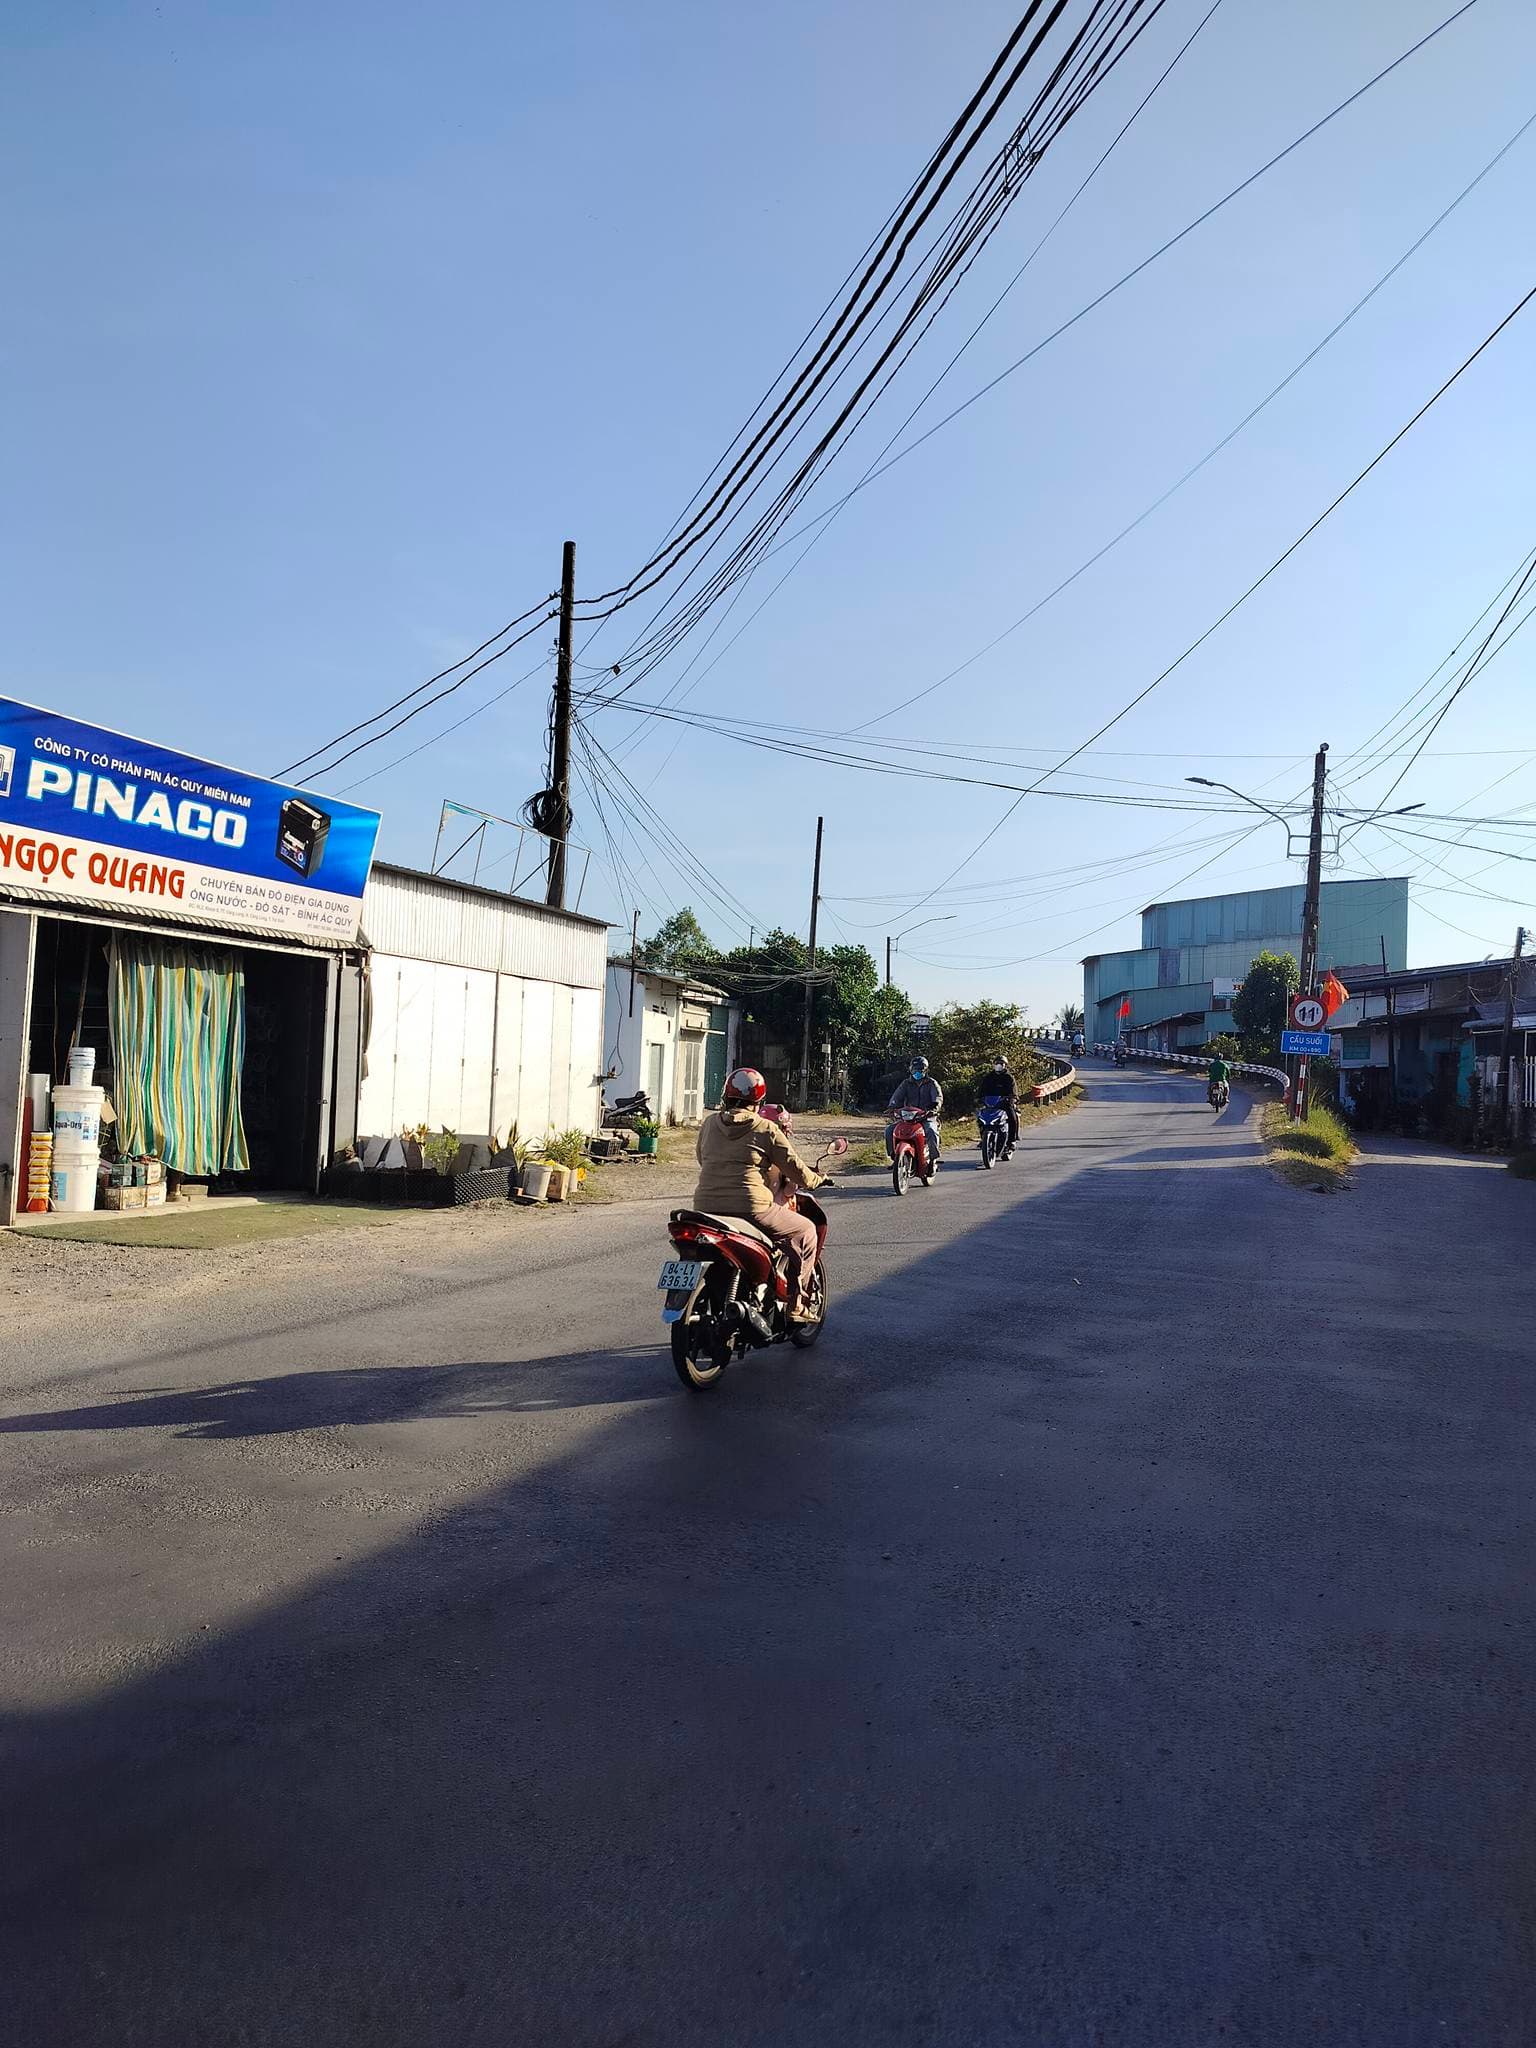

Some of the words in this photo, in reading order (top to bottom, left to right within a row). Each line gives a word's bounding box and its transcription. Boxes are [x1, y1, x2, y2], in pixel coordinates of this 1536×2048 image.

[34, 737, 71, 757] CÔNG
[73, 748, 90, 762] TY
[144, 768, 162, 783] PIN
[180, 779, 203, 794] QUY
[229, 792, 252, 808] NAM
[27, 758, 247, 848] PINACO
[0, 834, 77, 883] NGỌC
[88, 852, 185, 899] QUANG
[308, 897, 323, 908] GIA
[325, 901, 350, 914] DỤNG
[335, 916, 353, 927] QUY
[668, 1263, 695, 1275] 84-L1
